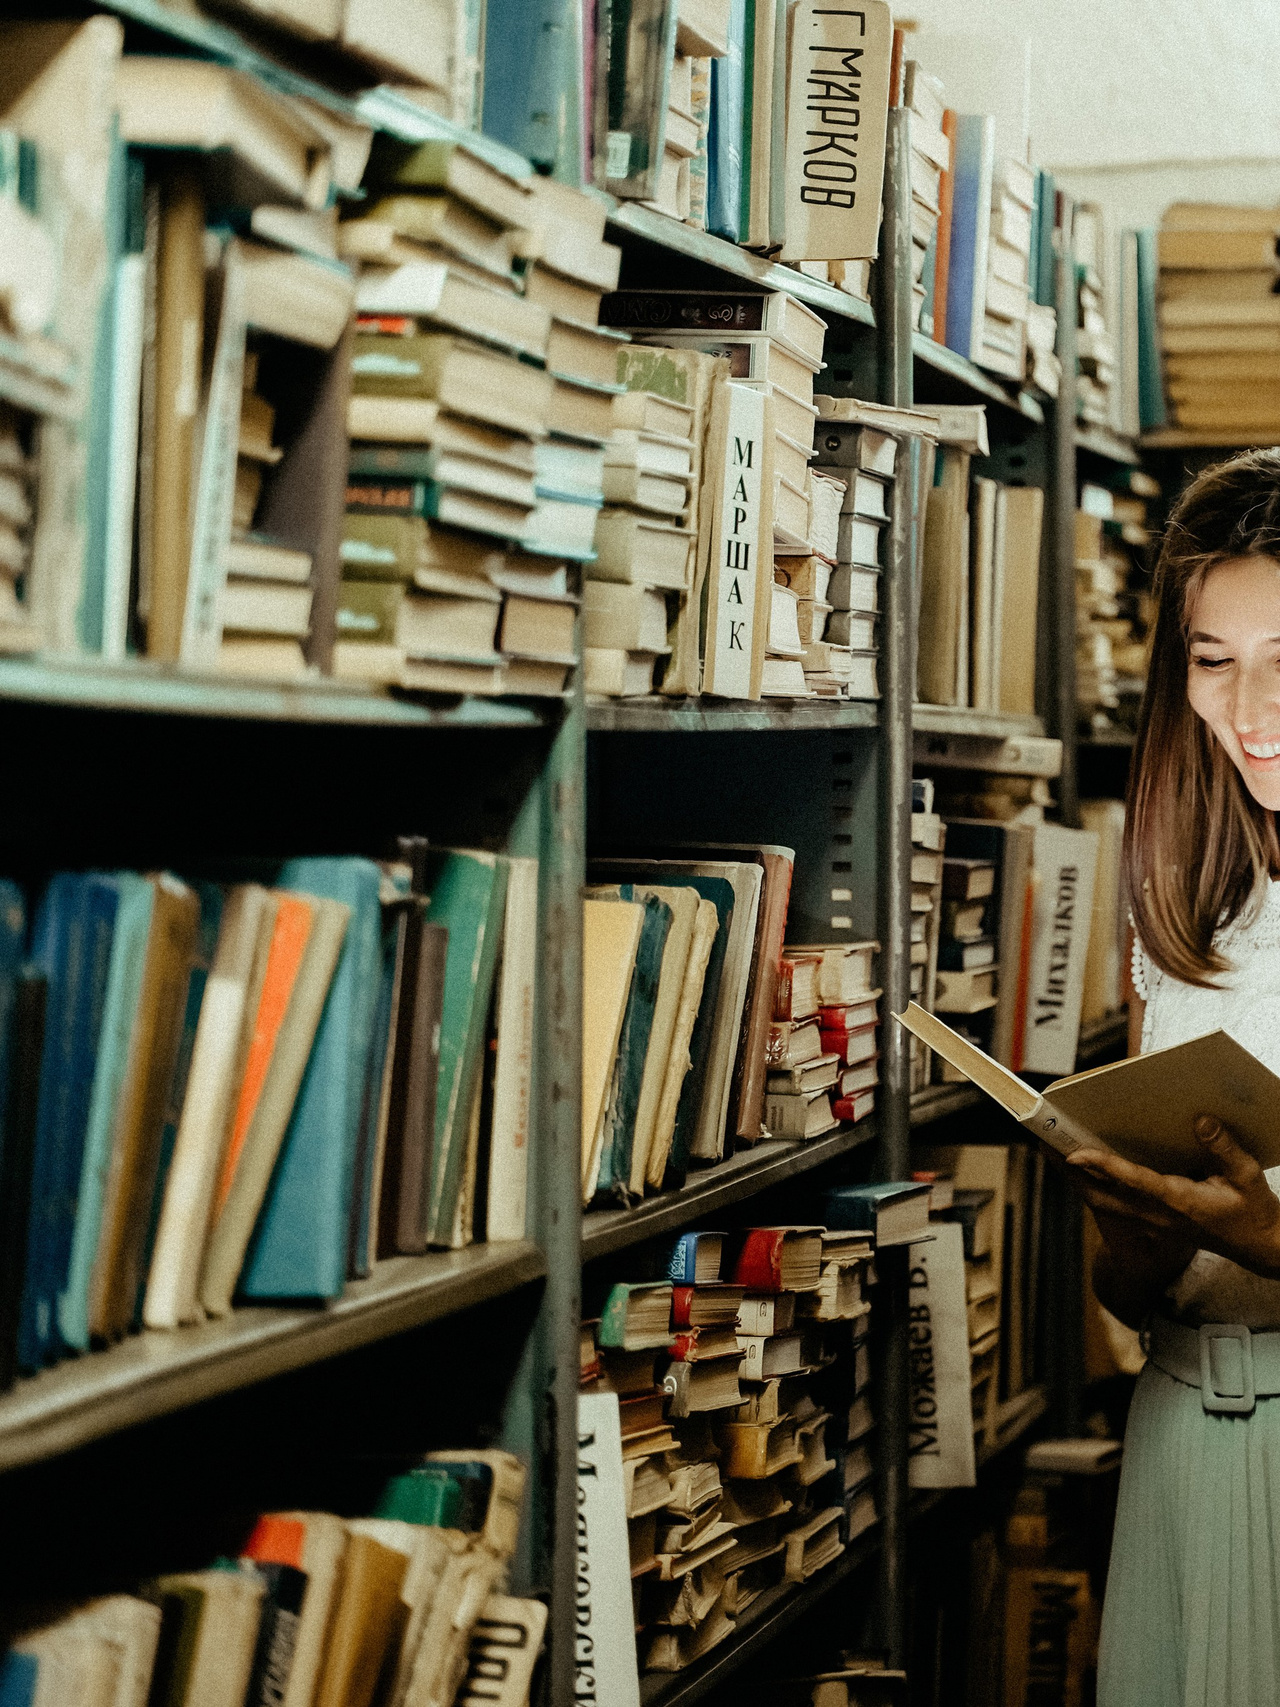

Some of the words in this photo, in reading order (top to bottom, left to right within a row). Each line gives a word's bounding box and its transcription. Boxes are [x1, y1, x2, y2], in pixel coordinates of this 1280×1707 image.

[811, 9, 866, 37] Г.
[800, 45, 864, 209] МАРКОВ
[725, 436, 754, 651] МАРШАК
[1035, 866, 1079, 1032] Михалков
[907, 1303, 940, 1457] Можаев
[575, 1431, 597, 1707] Мовск
